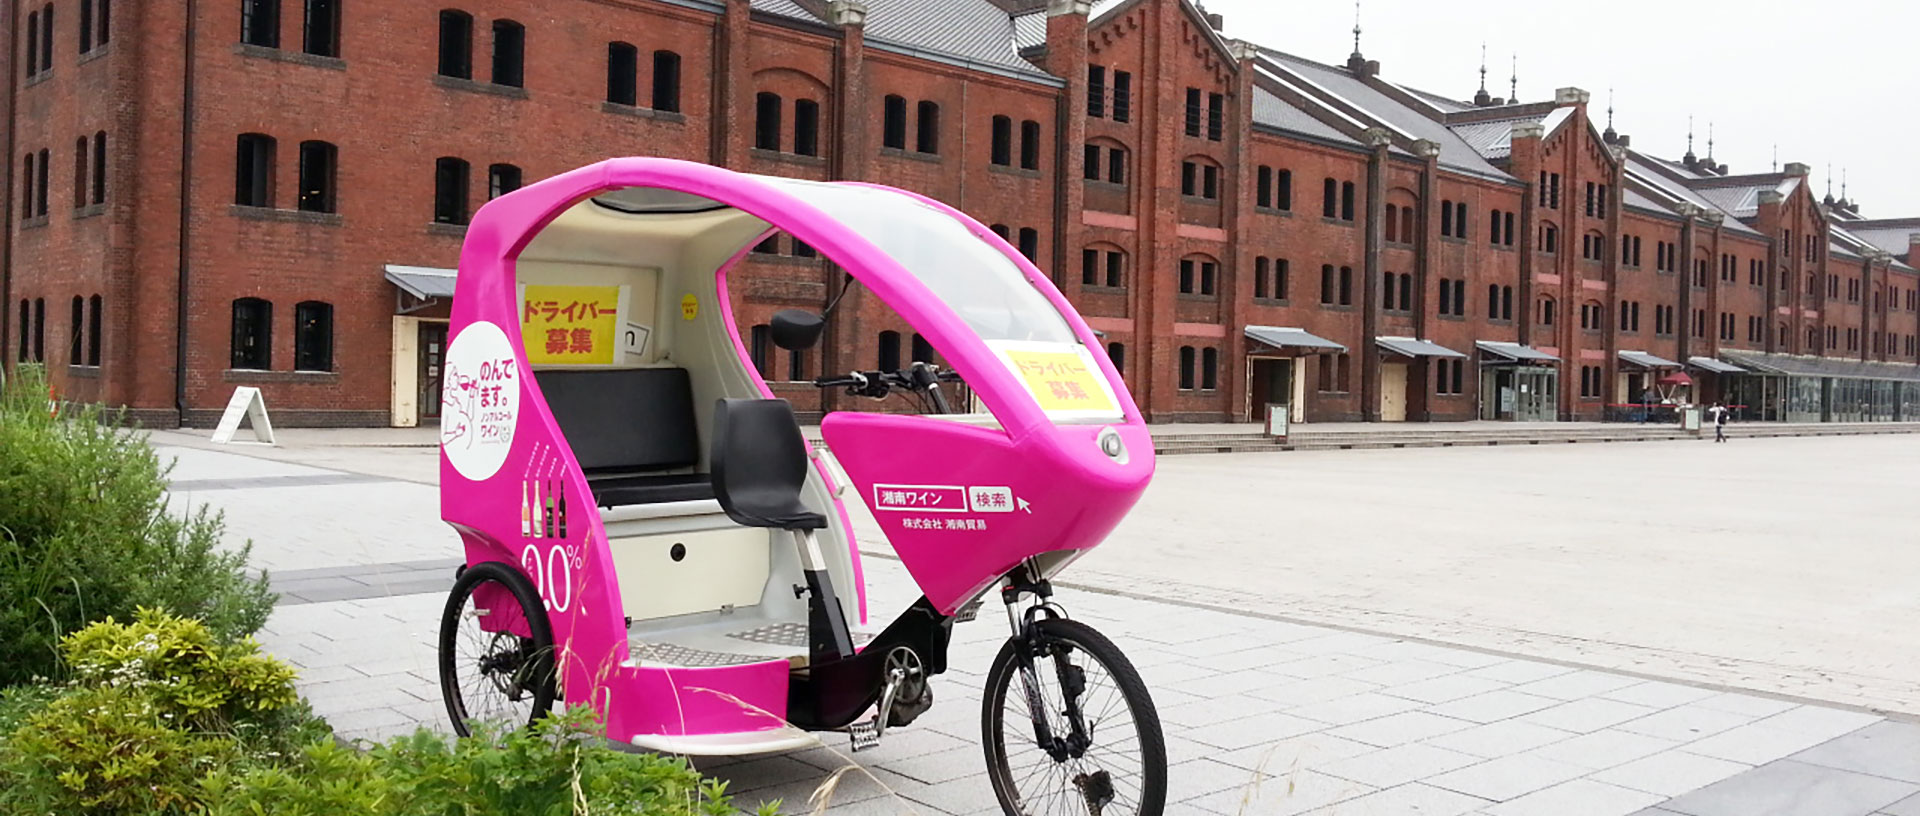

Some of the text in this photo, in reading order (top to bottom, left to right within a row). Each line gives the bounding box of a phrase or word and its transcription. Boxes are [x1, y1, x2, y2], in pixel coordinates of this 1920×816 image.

[524, 300, 617, 323] ドライバー
[545, 328, 593, 355] 募集
[480, 359, 514, 381] のんで
[1015, 359, 1087, 376] ドライバー
[481, 384, 508, 407] ます。
[1047, 380, 1091, 400] 募集
[481, 411, 512, 422] ノンアルコール
[481, 424, 499, 438] ワイン
[881, 490, 943, 506] 湘南ワイン
[975, 492, 1007, 508] 検索
[902, 517, 943, 530] 株式会社
